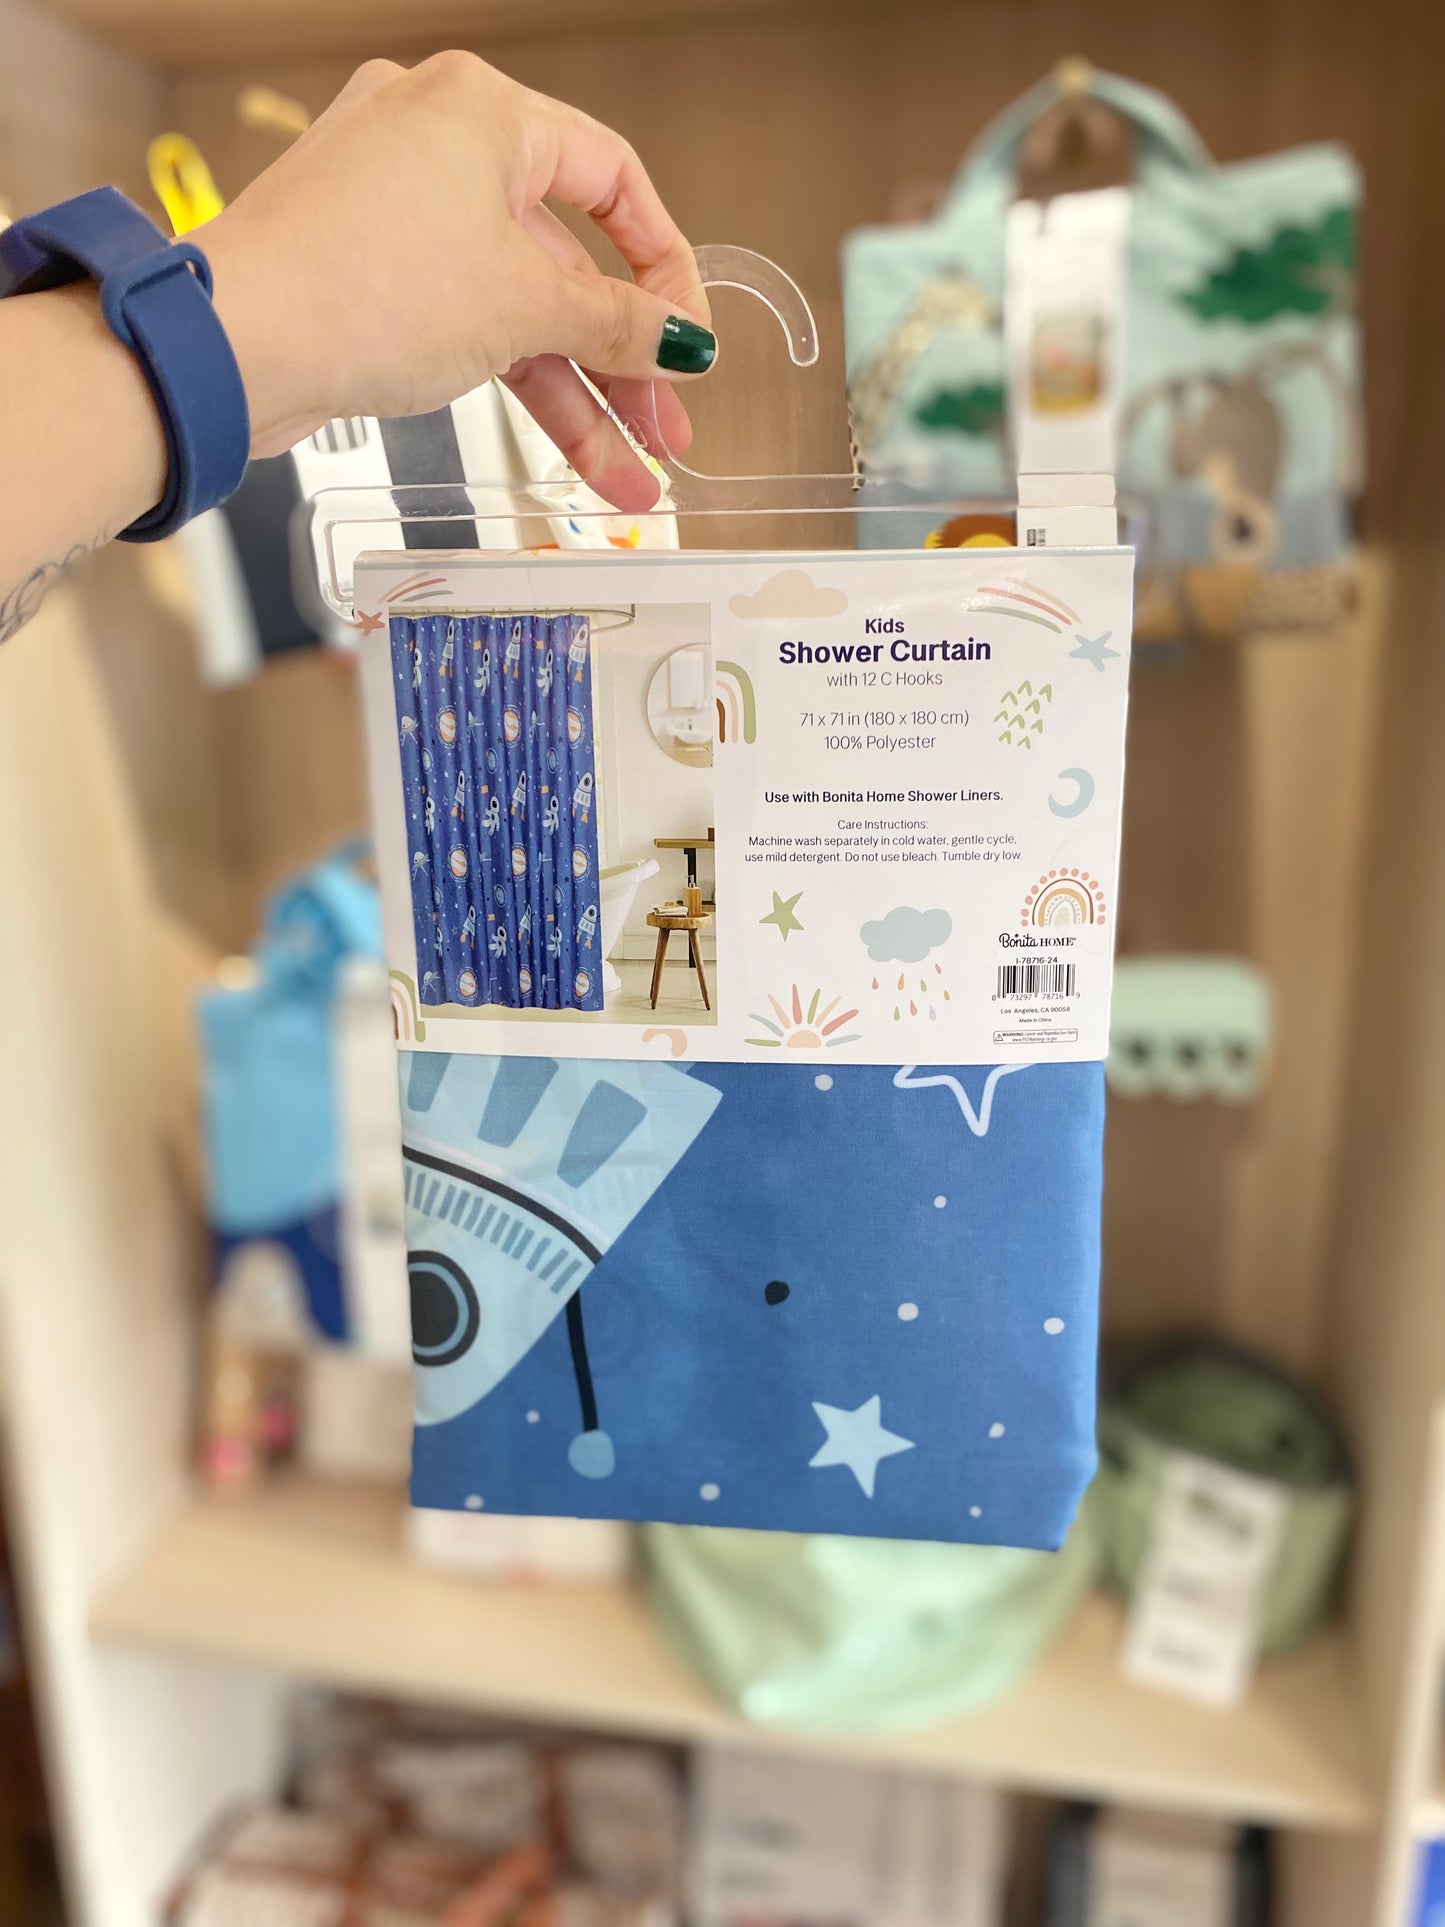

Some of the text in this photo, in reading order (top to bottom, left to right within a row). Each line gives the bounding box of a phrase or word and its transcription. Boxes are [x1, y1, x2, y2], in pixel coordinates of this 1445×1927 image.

[866, 618, 904, 633] Kids
[779, 637, 990, 664] Shower Curtain
[827, 671, 942, 686] with 12 C Hooks
[800, 710, 969, 728] 71 x 71 in (180 x 180 cm)
[825, 735, 936, 752] 100% Polyester
[765, 790, 1003, 803] Use with Bonita Home Shower Liners.
[838, 819, 928, 829] Care Instructions:
[749, 834, 1016, 848] Machine wash separately in cold water, gentle cycle,
[745, 854, 763, 862] use
[766, 852, 786, 861] mild
[789, 852, 842, 864] detergent.
[845, 852, 859, 862] Do
[862, 853, 878, 861] not
[902, 852, 939, 861] bleach.
[942, 851, 981, 861] Tumble
[983, 851, 1000, 862] dry
[1003, 851, 1022, 860] low.
[999, 933, 1038, 948] Bonita
